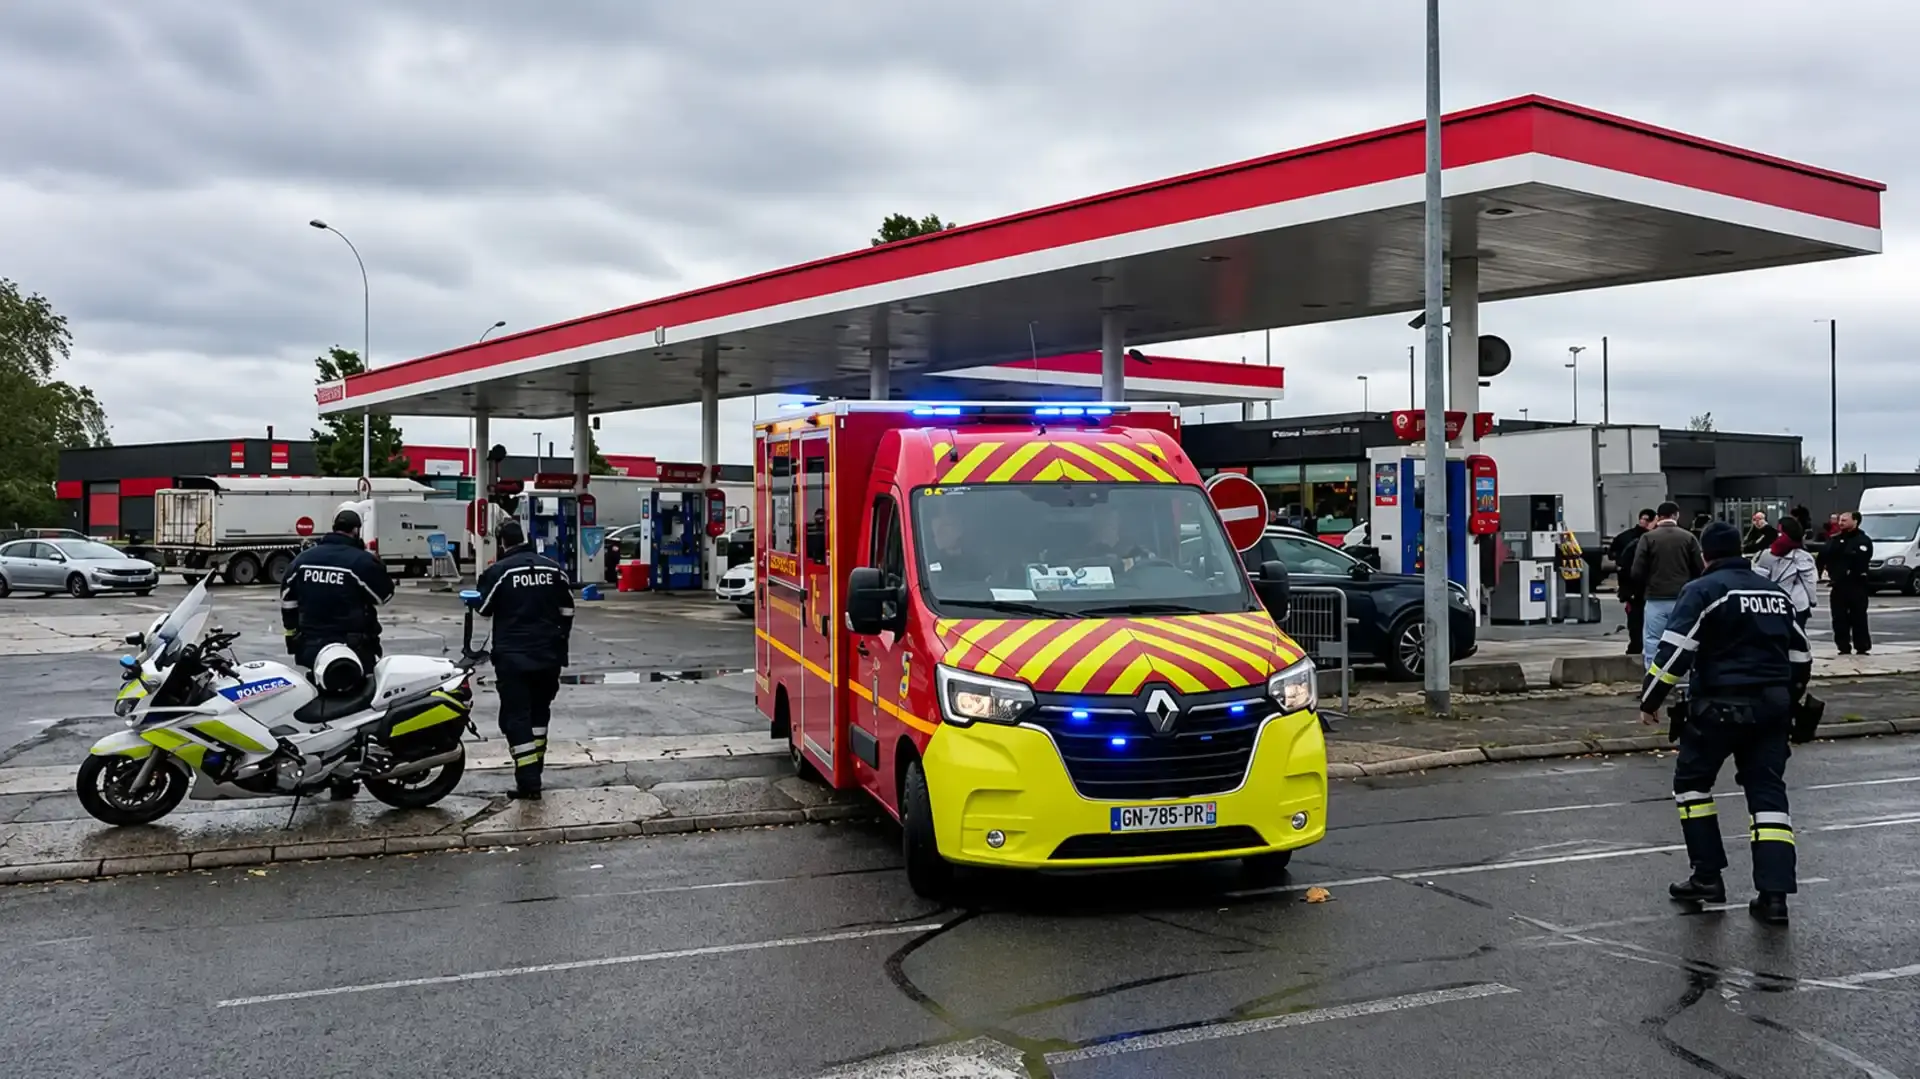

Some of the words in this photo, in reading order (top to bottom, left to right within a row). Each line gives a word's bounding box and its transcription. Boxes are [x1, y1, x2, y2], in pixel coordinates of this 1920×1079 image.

[304, 570, 344, 585] POLICE
[512, 573, 553, 588] POLICE
[1740, 596, 1788, 614] POLICE
[1122, 804, 1204, 827] GN-785-PR
